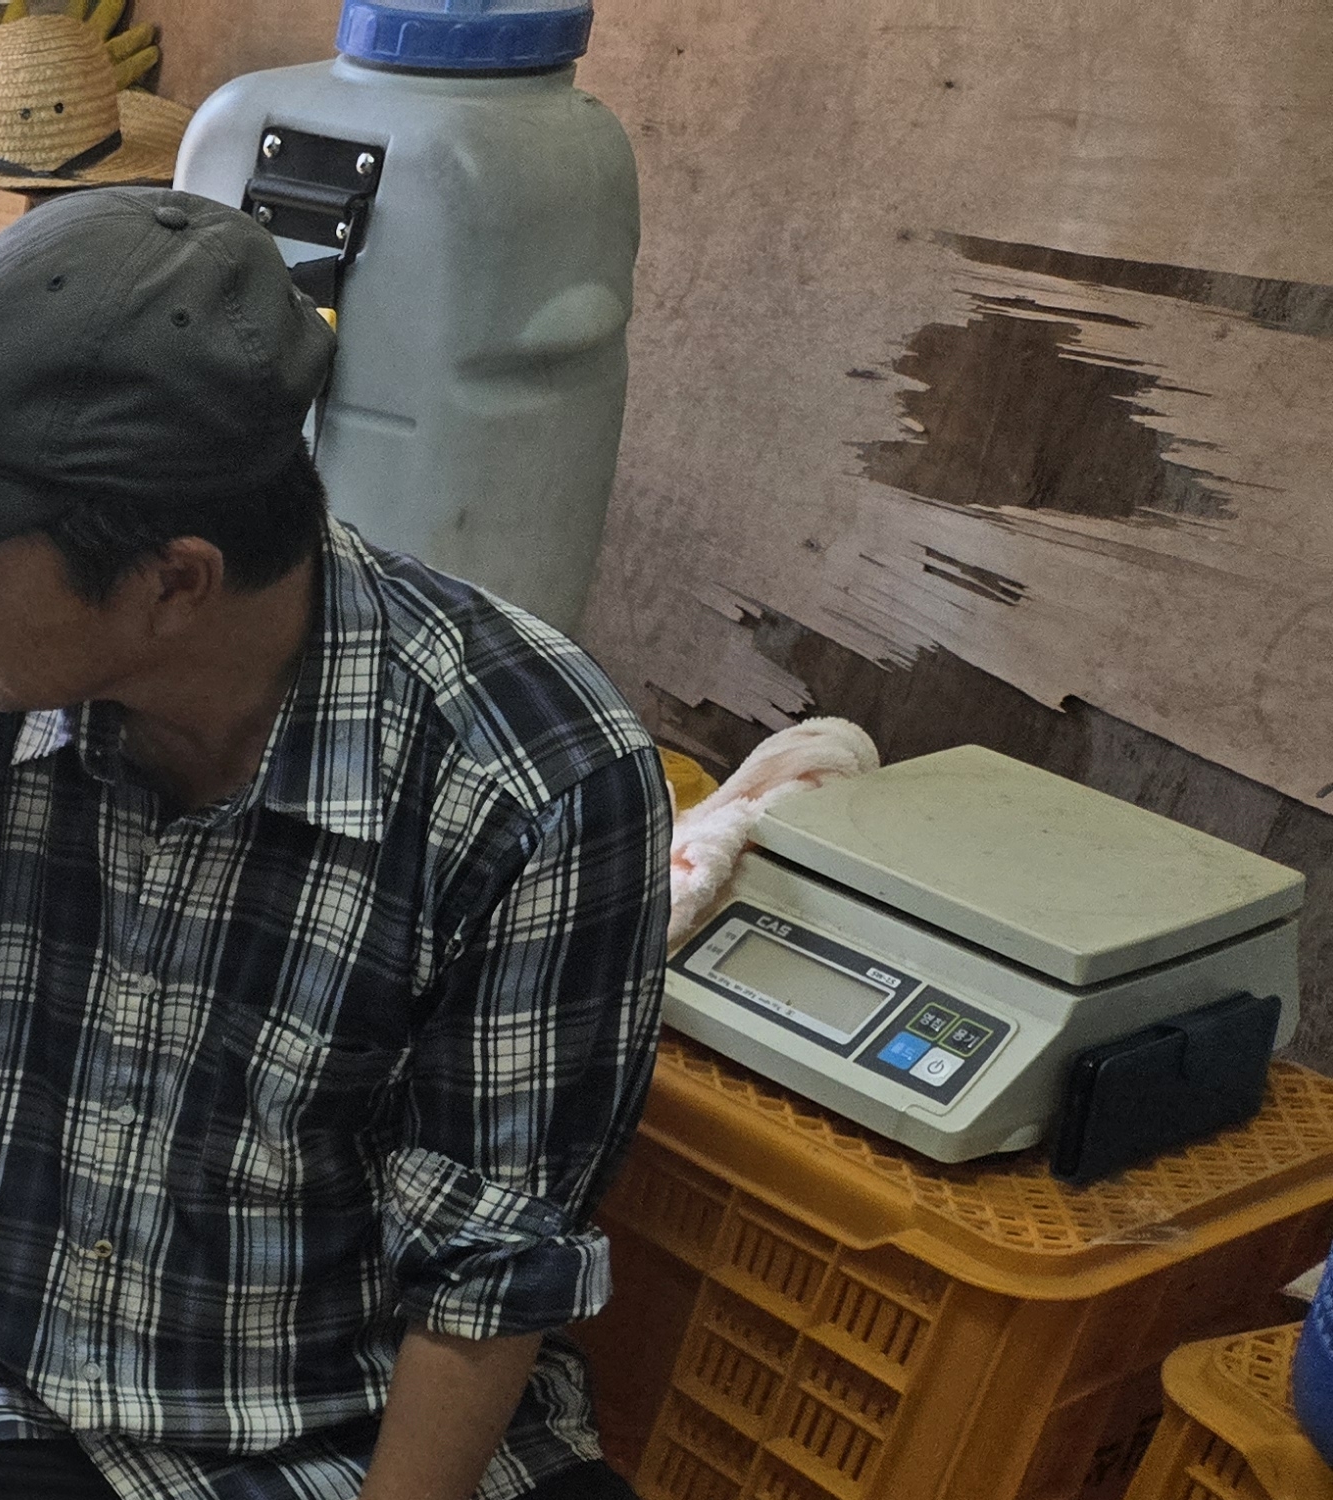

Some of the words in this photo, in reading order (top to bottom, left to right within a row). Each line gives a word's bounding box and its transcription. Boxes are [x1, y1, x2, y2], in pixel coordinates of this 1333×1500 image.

[755, 915, 792, 938] CAS
[920, 1011, 947, 1032] 영점
[952, 1028, 980, 1049] 용기
